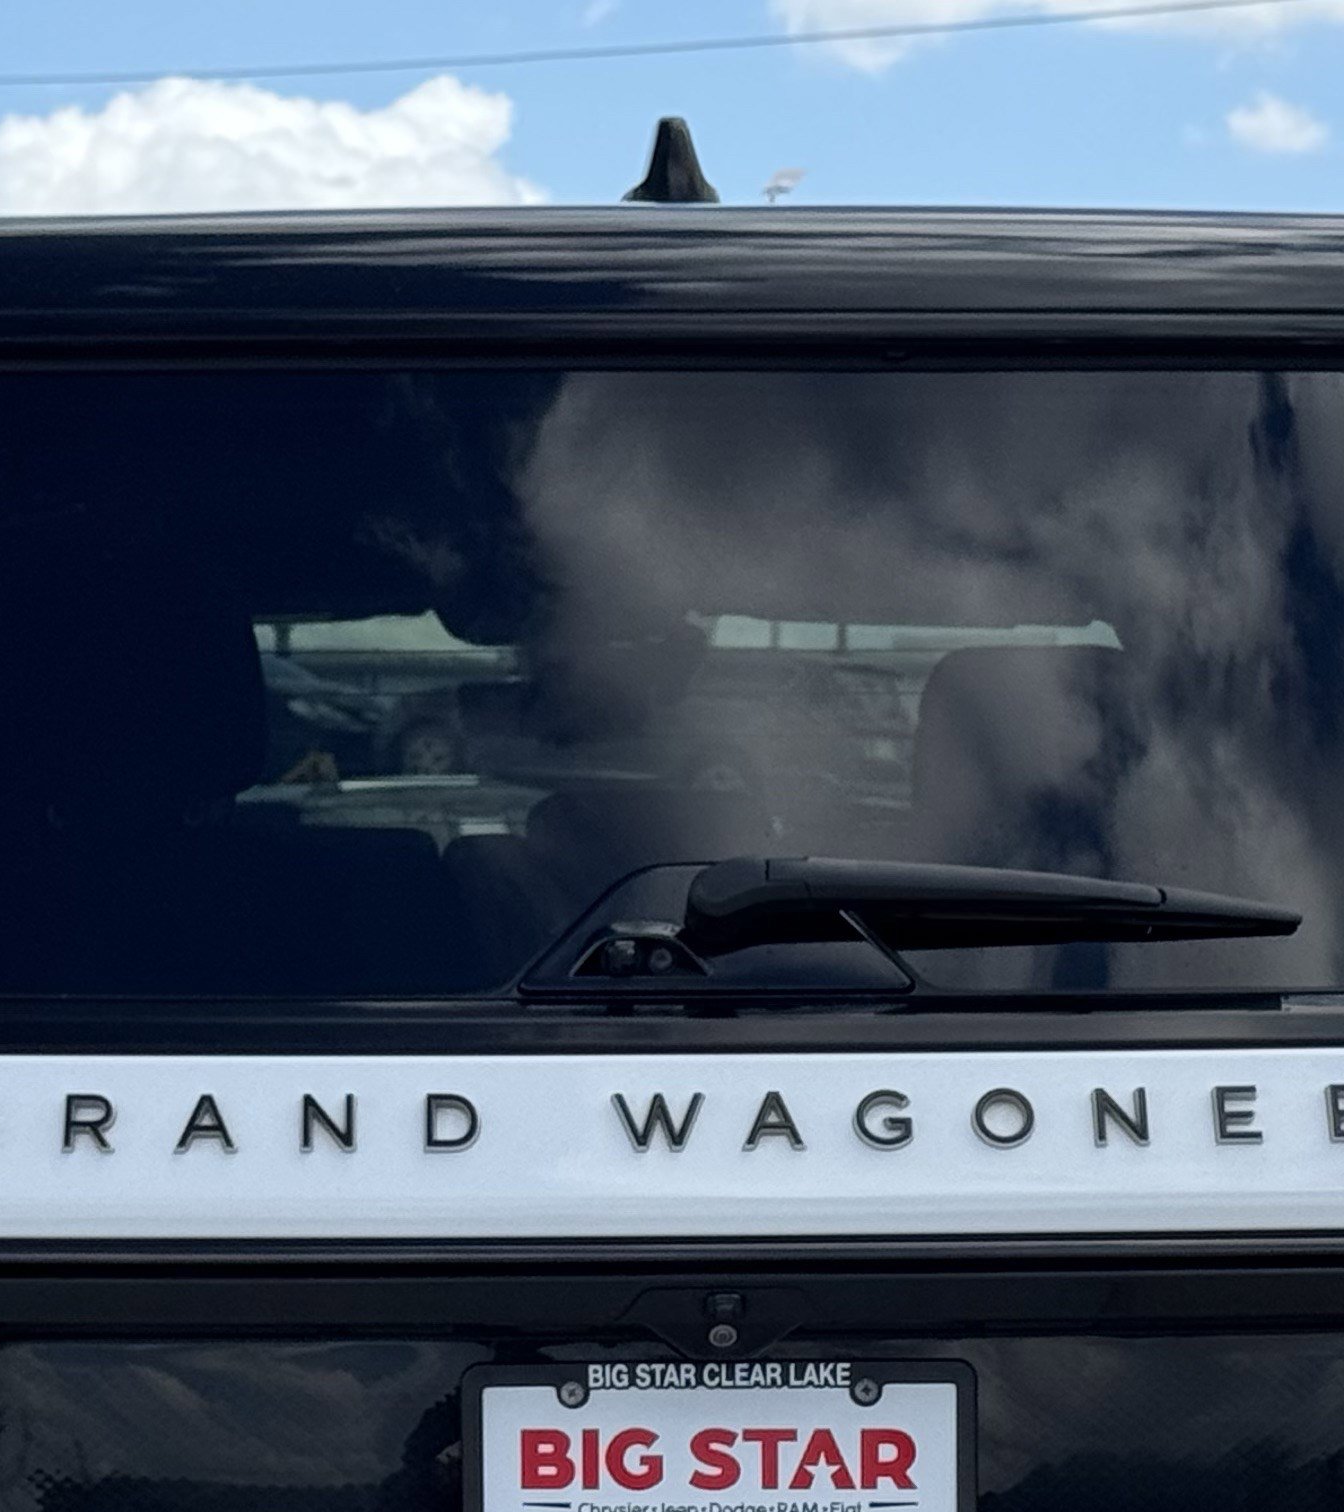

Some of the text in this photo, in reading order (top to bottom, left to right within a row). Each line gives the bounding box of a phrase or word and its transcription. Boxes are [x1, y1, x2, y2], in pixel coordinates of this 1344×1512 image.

[587, 1362, 852, 1388] BIG STAR CLEAR LAKE
[520, 1427, 918, 1491] BIG STAR
